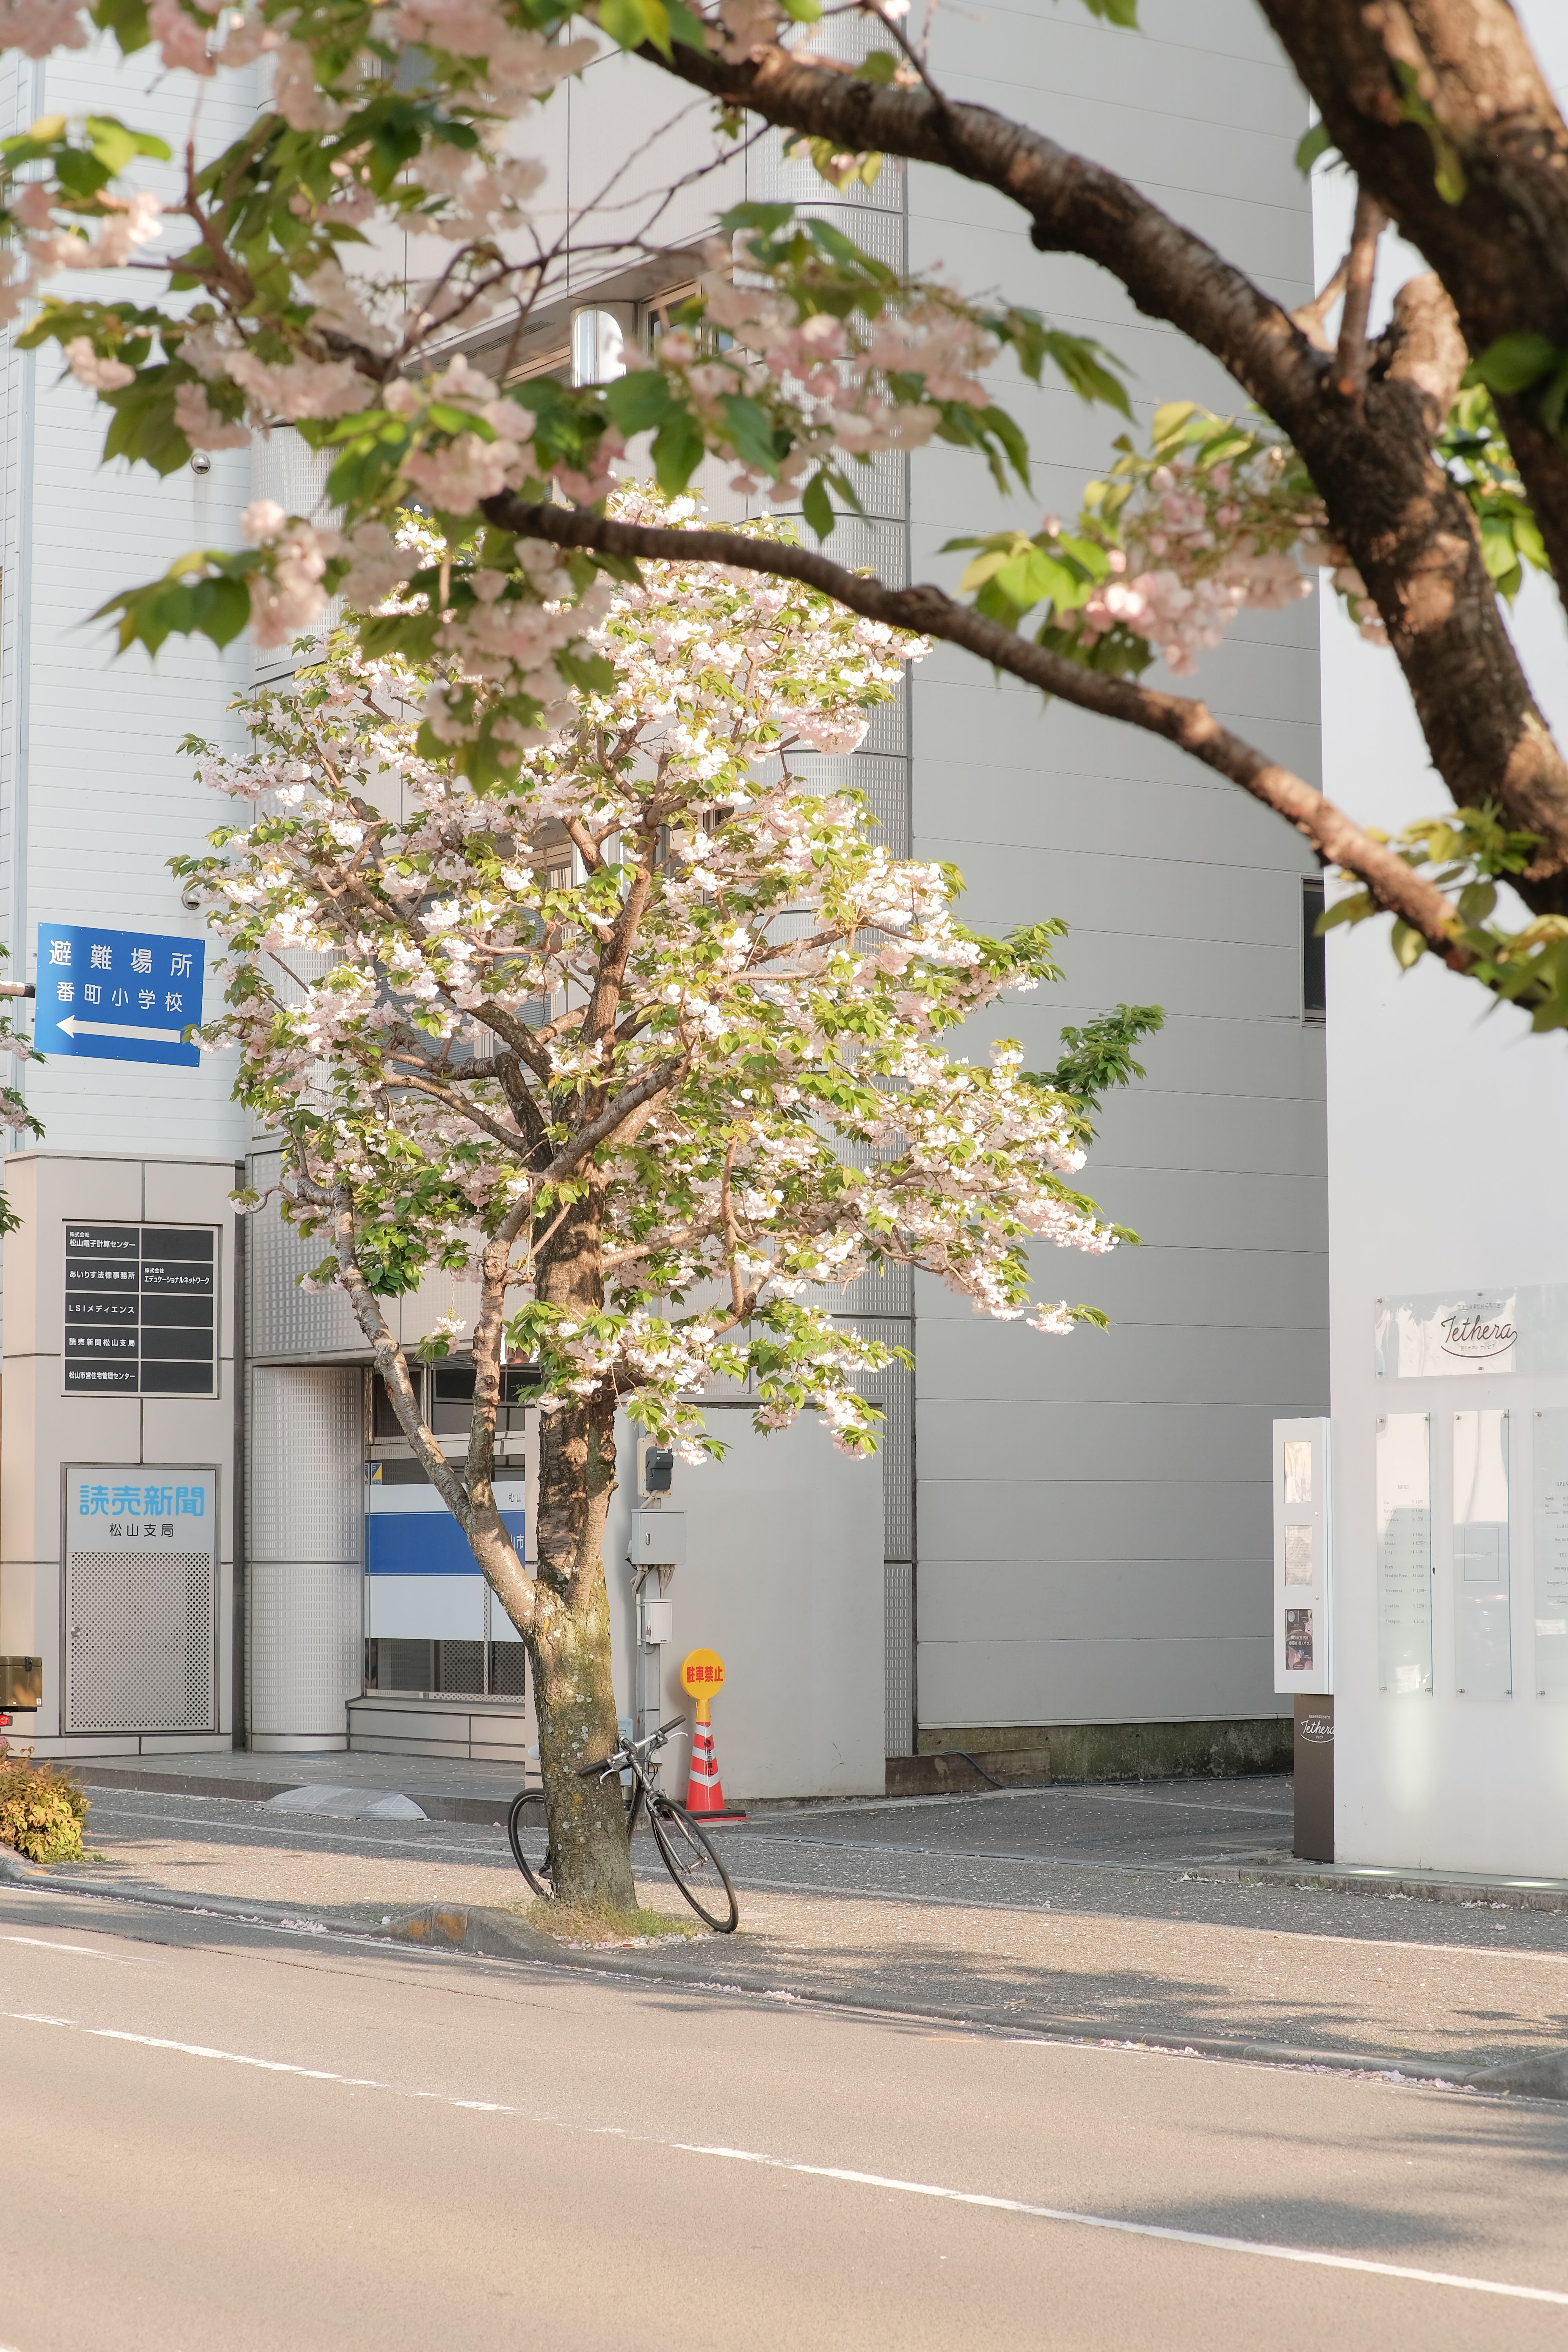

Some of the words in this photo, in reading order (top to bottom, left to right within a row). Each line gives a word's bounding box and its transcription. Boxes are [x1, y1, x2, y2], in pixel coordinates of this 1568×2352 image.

[49, 940, 193, 978] 避難場所
[56, 981, 182, 1013] 番町小学校
[69, 1239, 136, 1248] 松山電子計算センター
[69, 1270, 135, 1280] あいりす法律事務所
[144, 1275, 209, 1285] エデュケーショナルネットワーク
[69, 1305, 135, 1314] LSIメディエンス
[1441, 1314, 1516, 1344] Tethera
[69, 1338, 135, 1347] 読売新聞松山支局
[69, 1371, 135, 1380] 松山市営住宅管理センター
[79, 1485, 204, 1516] 読売新聞
[509, 1493, 525, 1503] 松山
[109, 1523, 174, 1537] 松山支局
[686, 1665, 723, 1683] 駐車禁止
